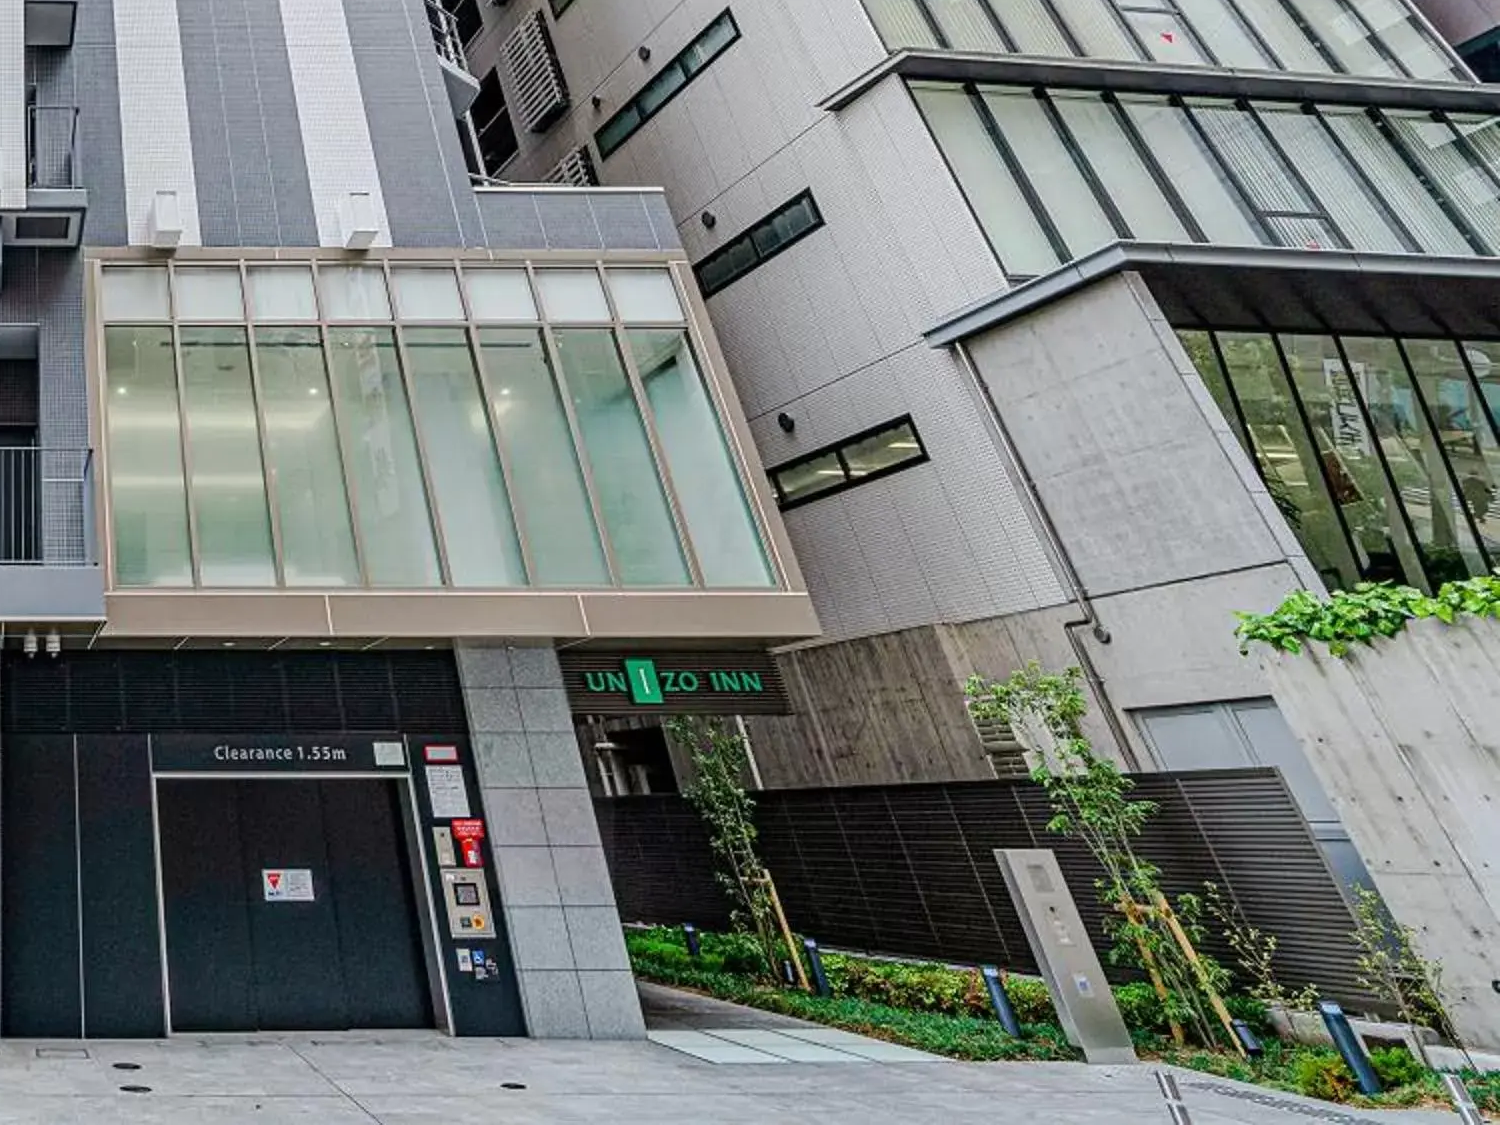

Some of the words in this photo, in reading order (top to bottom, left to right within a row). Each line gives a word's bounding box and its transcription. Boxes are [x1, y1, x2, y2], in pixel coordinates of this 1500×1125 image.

[586, 667, 700, 696] UNIZO
[709, 672, 763, 692] INN
[214, 746, 293, 761] Clearance
[297, 746, 347, 761] 1.55m
